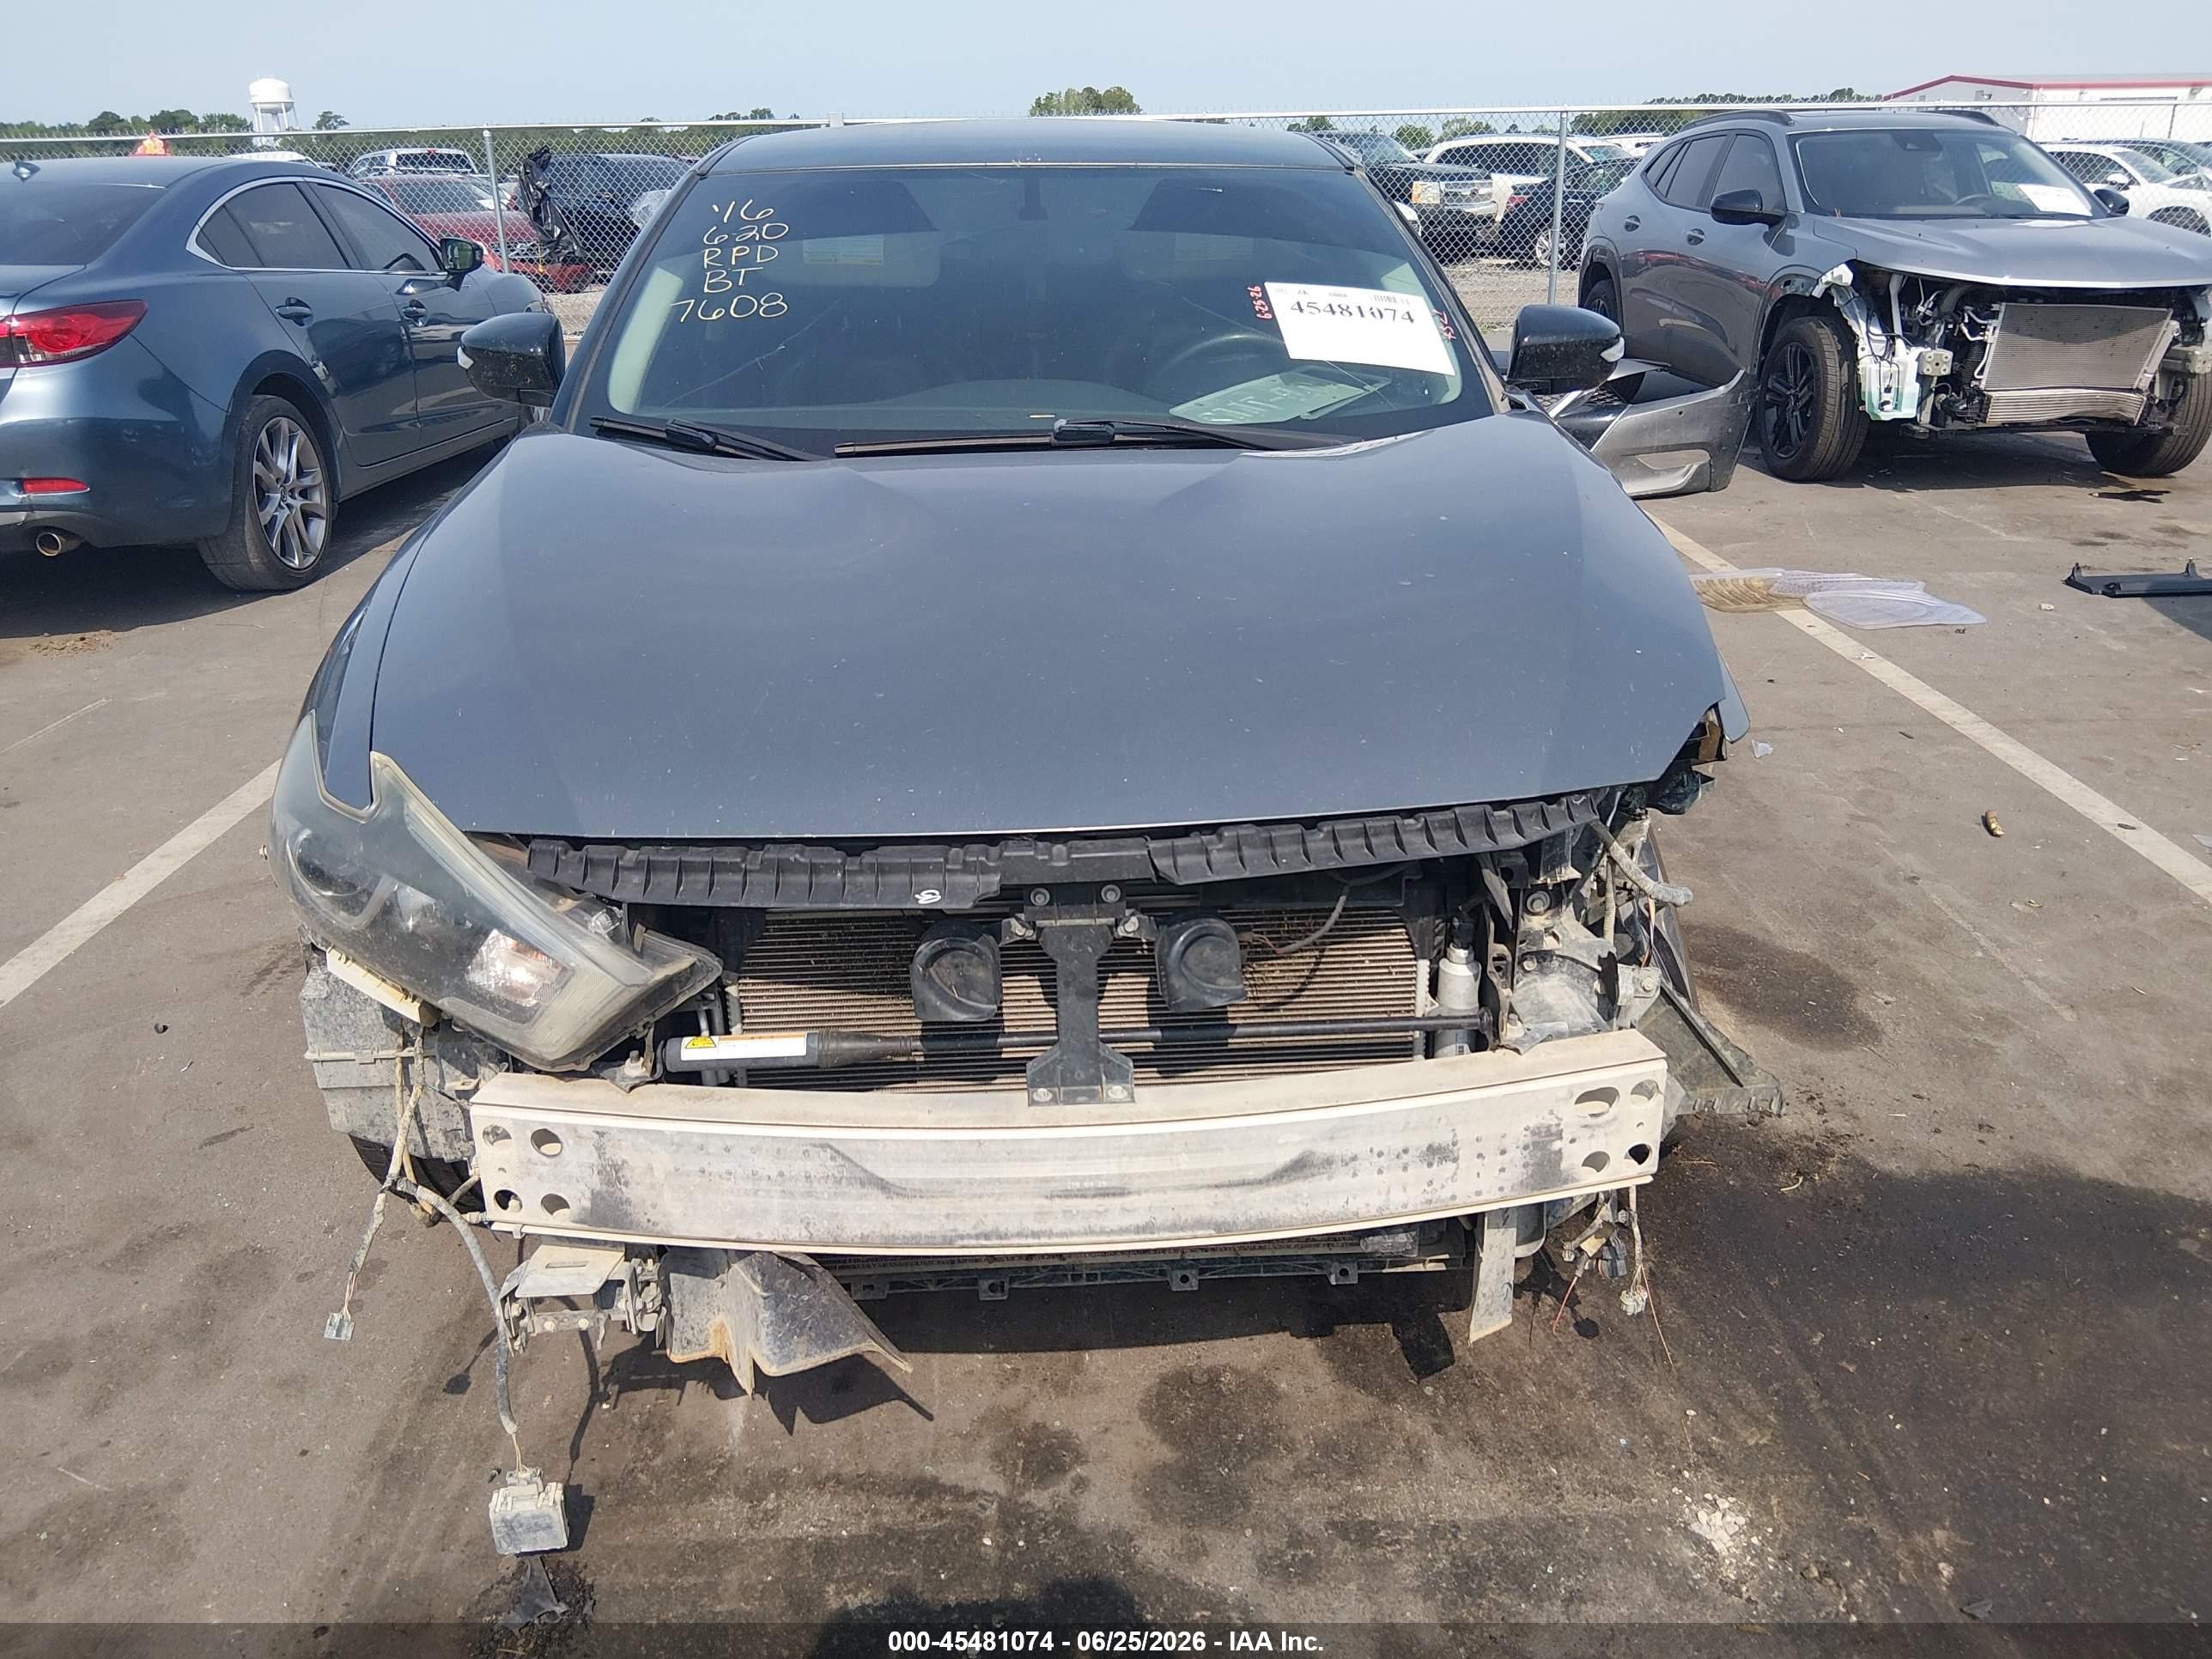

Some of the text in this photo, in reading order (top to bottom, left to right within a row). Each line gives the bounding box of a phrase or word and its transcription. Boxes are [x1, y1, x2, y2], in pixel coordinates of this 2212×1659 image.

[703, 266, 764, 294] BT
[669, 292, 788, 323] 7608
[1290, 301, 1416, 324] 45481074
